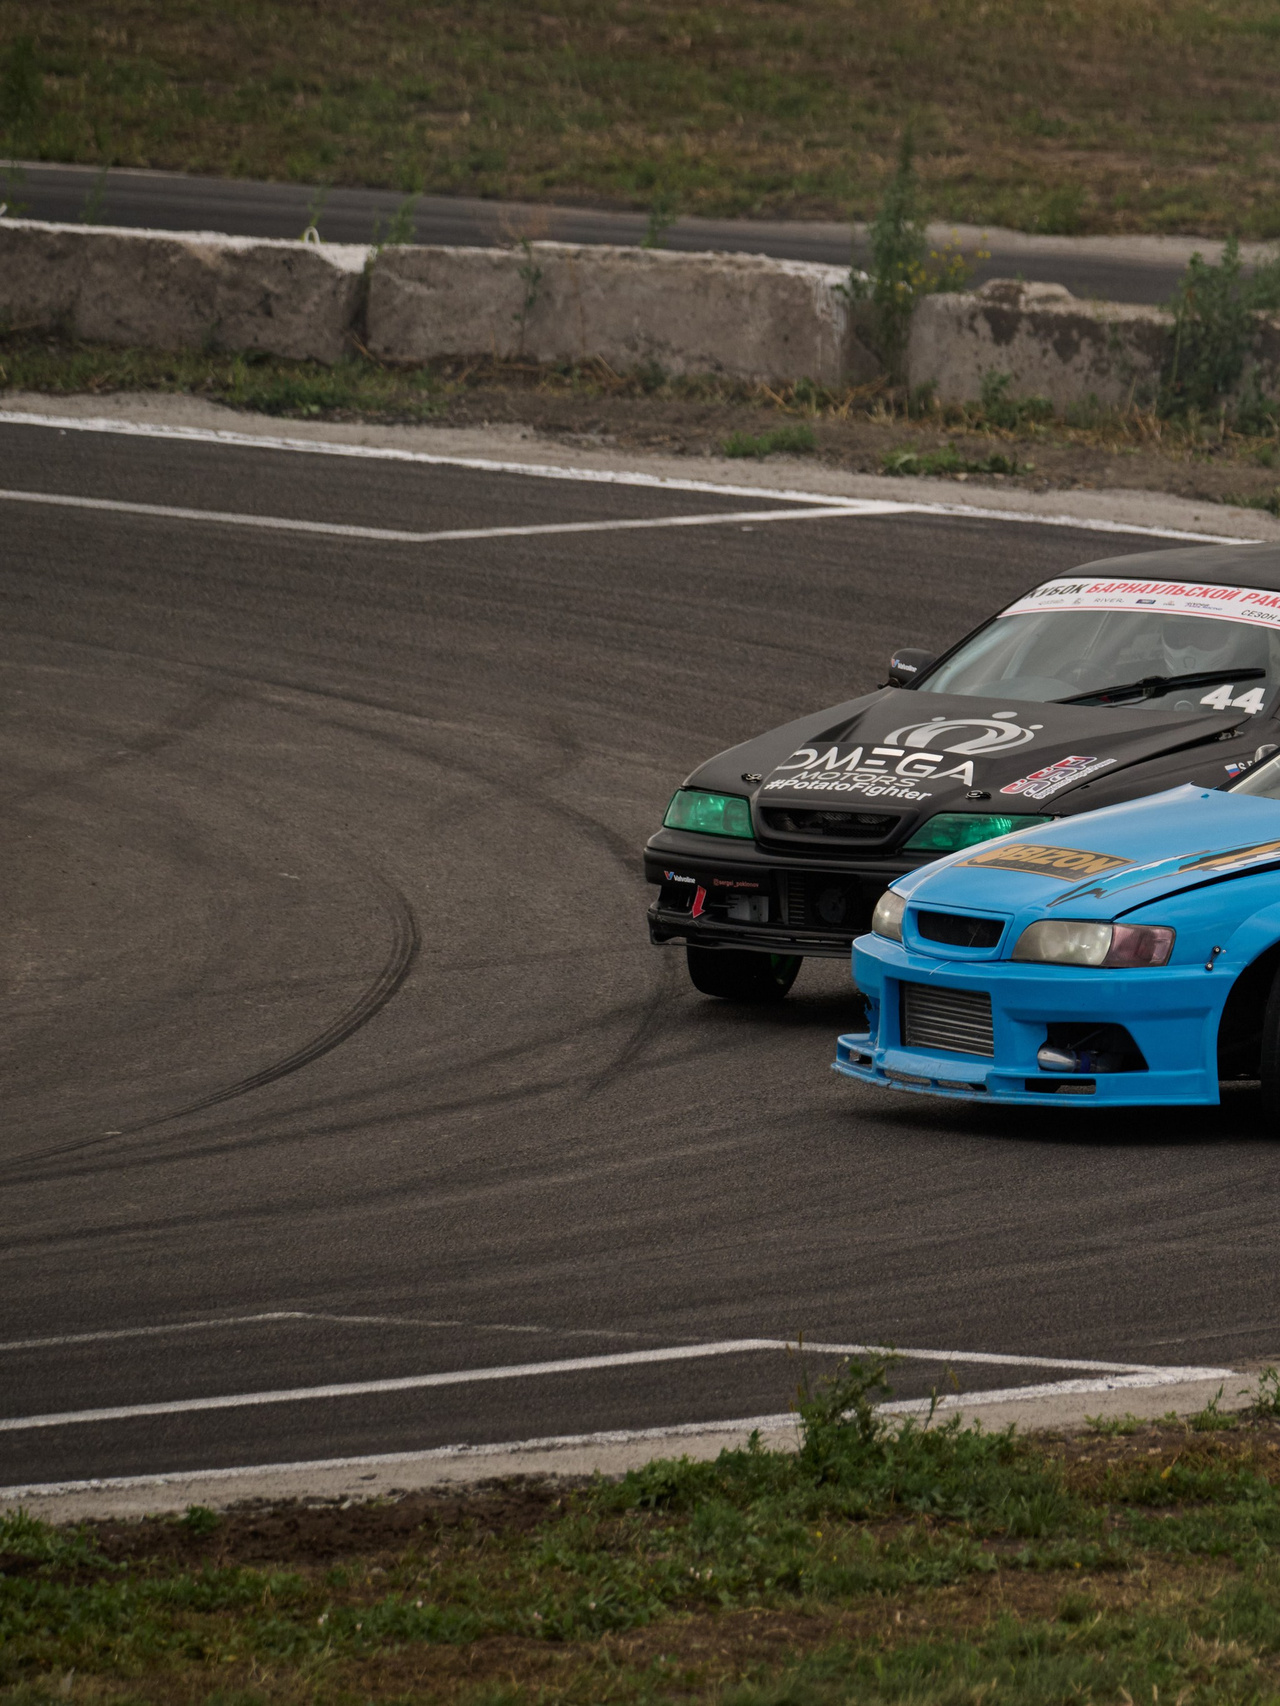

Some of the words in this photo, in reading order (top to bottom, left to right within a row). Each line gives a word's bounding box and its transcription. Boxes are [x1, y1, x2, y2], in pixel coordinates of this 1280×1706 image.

[1085, 583, 1242, 601] БАРНАУЛЬСКОЙ
[1241, 610, 1279, 621] СЕЗОН
[1200, 685, 1265, 714] 44
[791, 771, 920, 787] MOTORS
[764, 779, 933, 801] #PotatoFighter
[1001, 847, 1125, 874] BIZON
